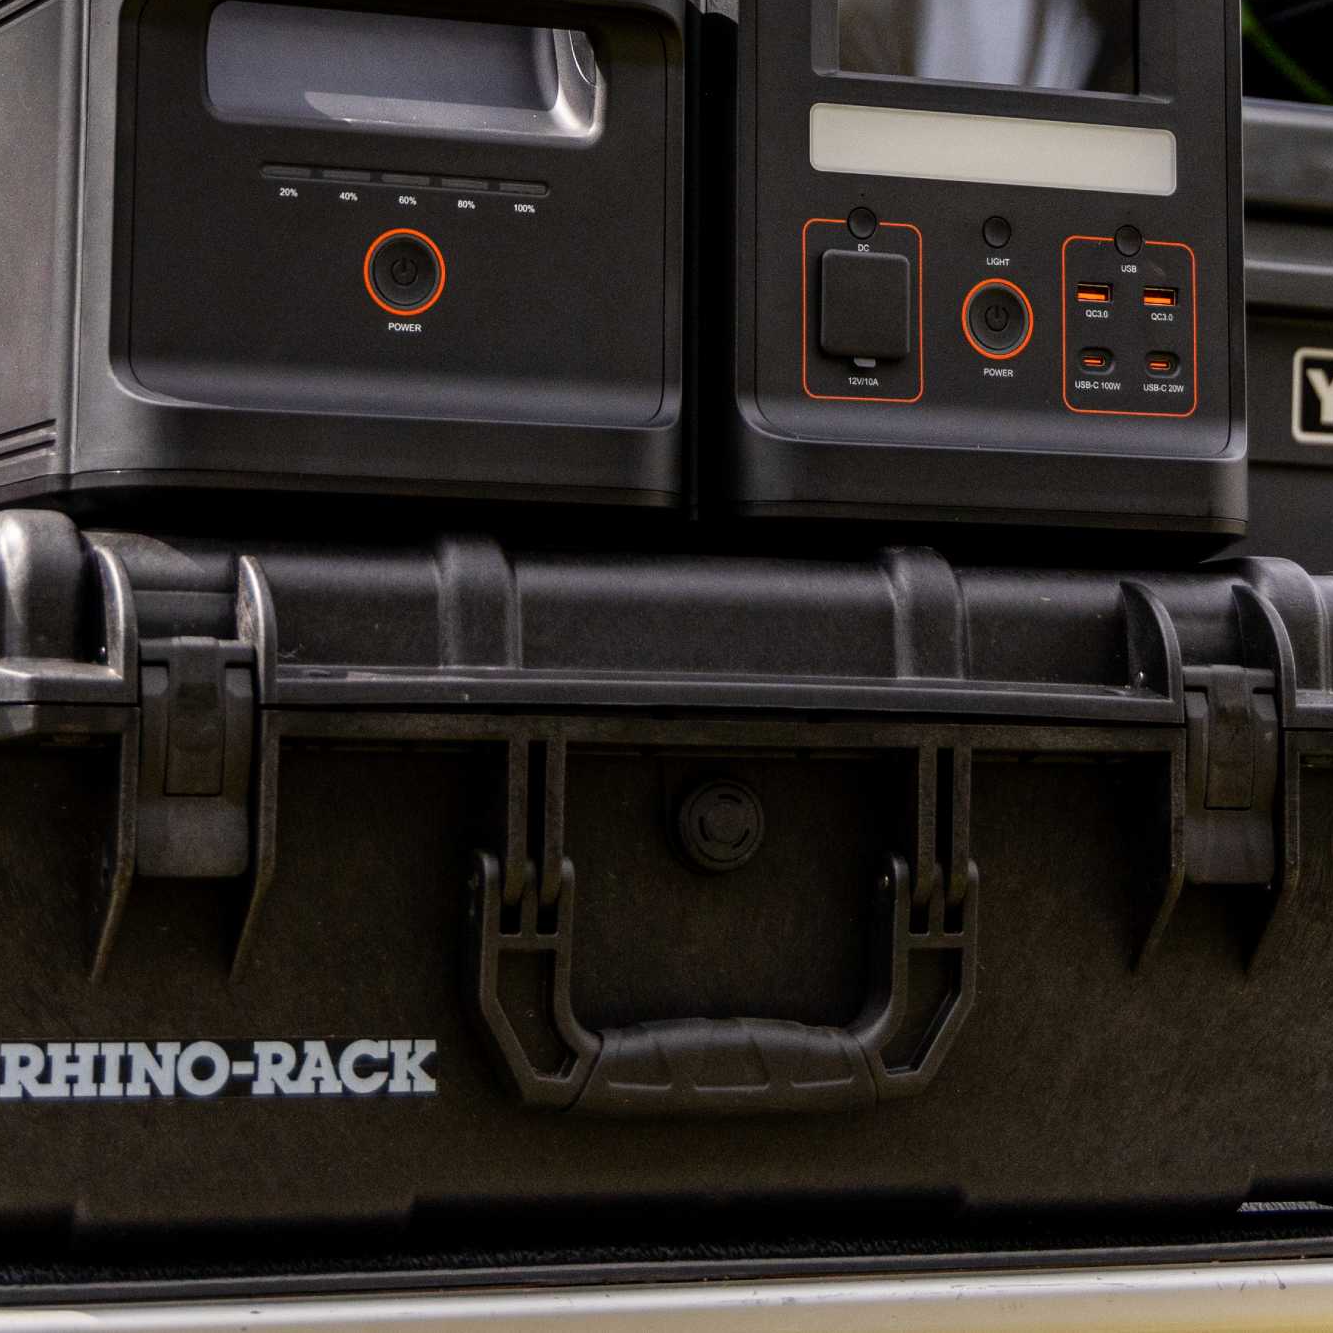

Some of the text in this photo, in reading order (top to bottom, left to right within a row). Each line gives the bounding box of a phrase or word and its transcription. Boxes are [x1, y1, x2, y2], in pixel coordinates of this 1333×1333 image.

[279, 187, 536, 214] 20% 40% 60% 80% 100%
[857, 243, 870, 253] DC
[986, 257, 1011, 267] LIGHT
[1121, 265, 1137, 273] USB
[1085, 309, 1109, 319] QC3.0
[1150, 312, 1174, 322] QC3.0
[388, 322, 422, 333] POWER
[983, 368, 1014, 378] POWER
[848, 377, 879, 387] 12V/10A
[1074, 380, 1121, 390] USB-C 100W
[1143, 383, 1184, 393] USB-C 20W
